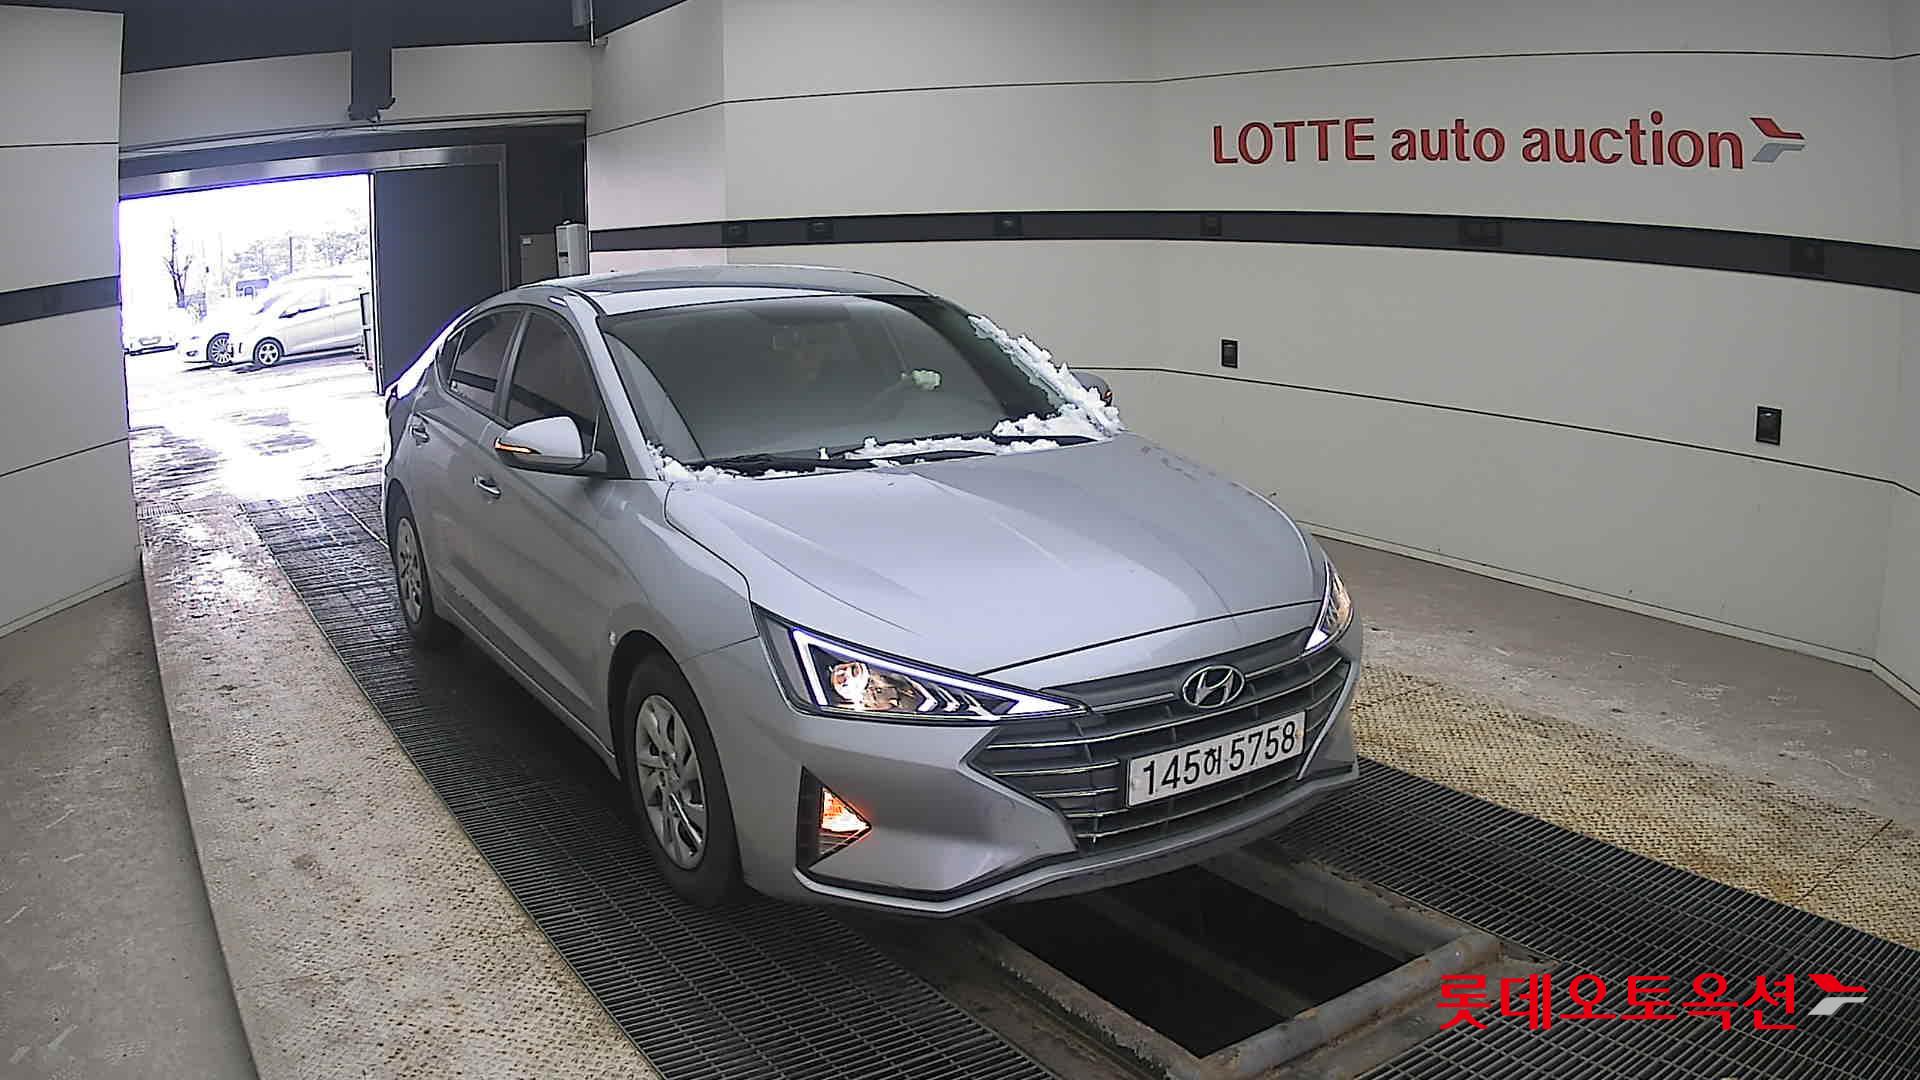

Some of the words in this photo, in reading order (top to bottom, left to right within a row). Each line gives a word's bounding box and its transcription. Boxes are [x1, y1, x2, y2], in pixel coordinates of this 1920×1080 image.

[1212, 118, 1374, 164] LOTTE
[1390, 120, 1505, 162] auto
[1522, 111, 1745, 169] auction
